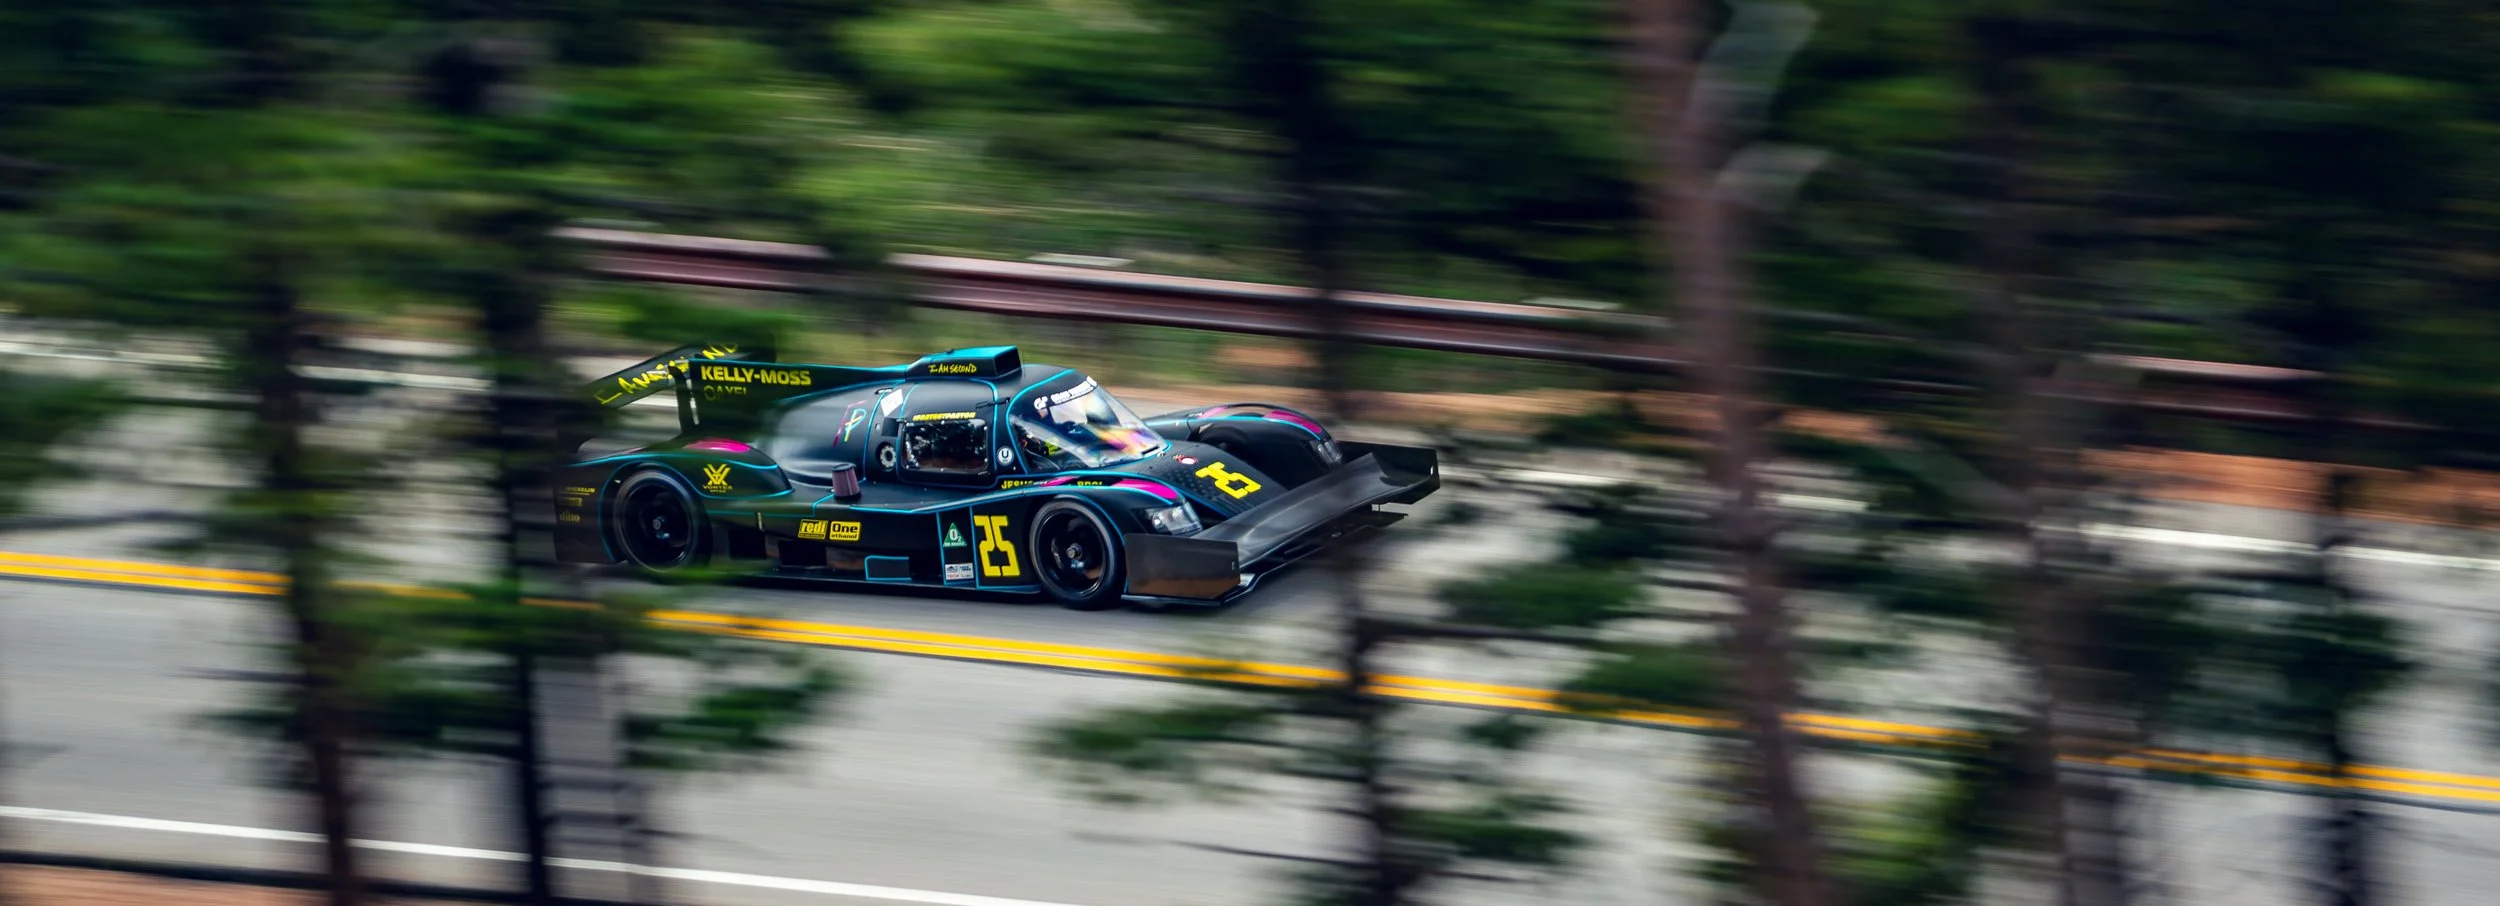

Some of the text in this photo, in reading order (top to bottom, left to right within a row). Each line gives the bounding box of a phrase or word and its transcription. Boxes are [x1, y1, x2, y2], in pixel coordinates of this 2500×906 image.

[700, 365, 812, 386] KELLY-MOSS
[949, 363, 977, 374] SECOND
[832, 523, 858, 533] One
[974, 515, 1020, 577] 25
